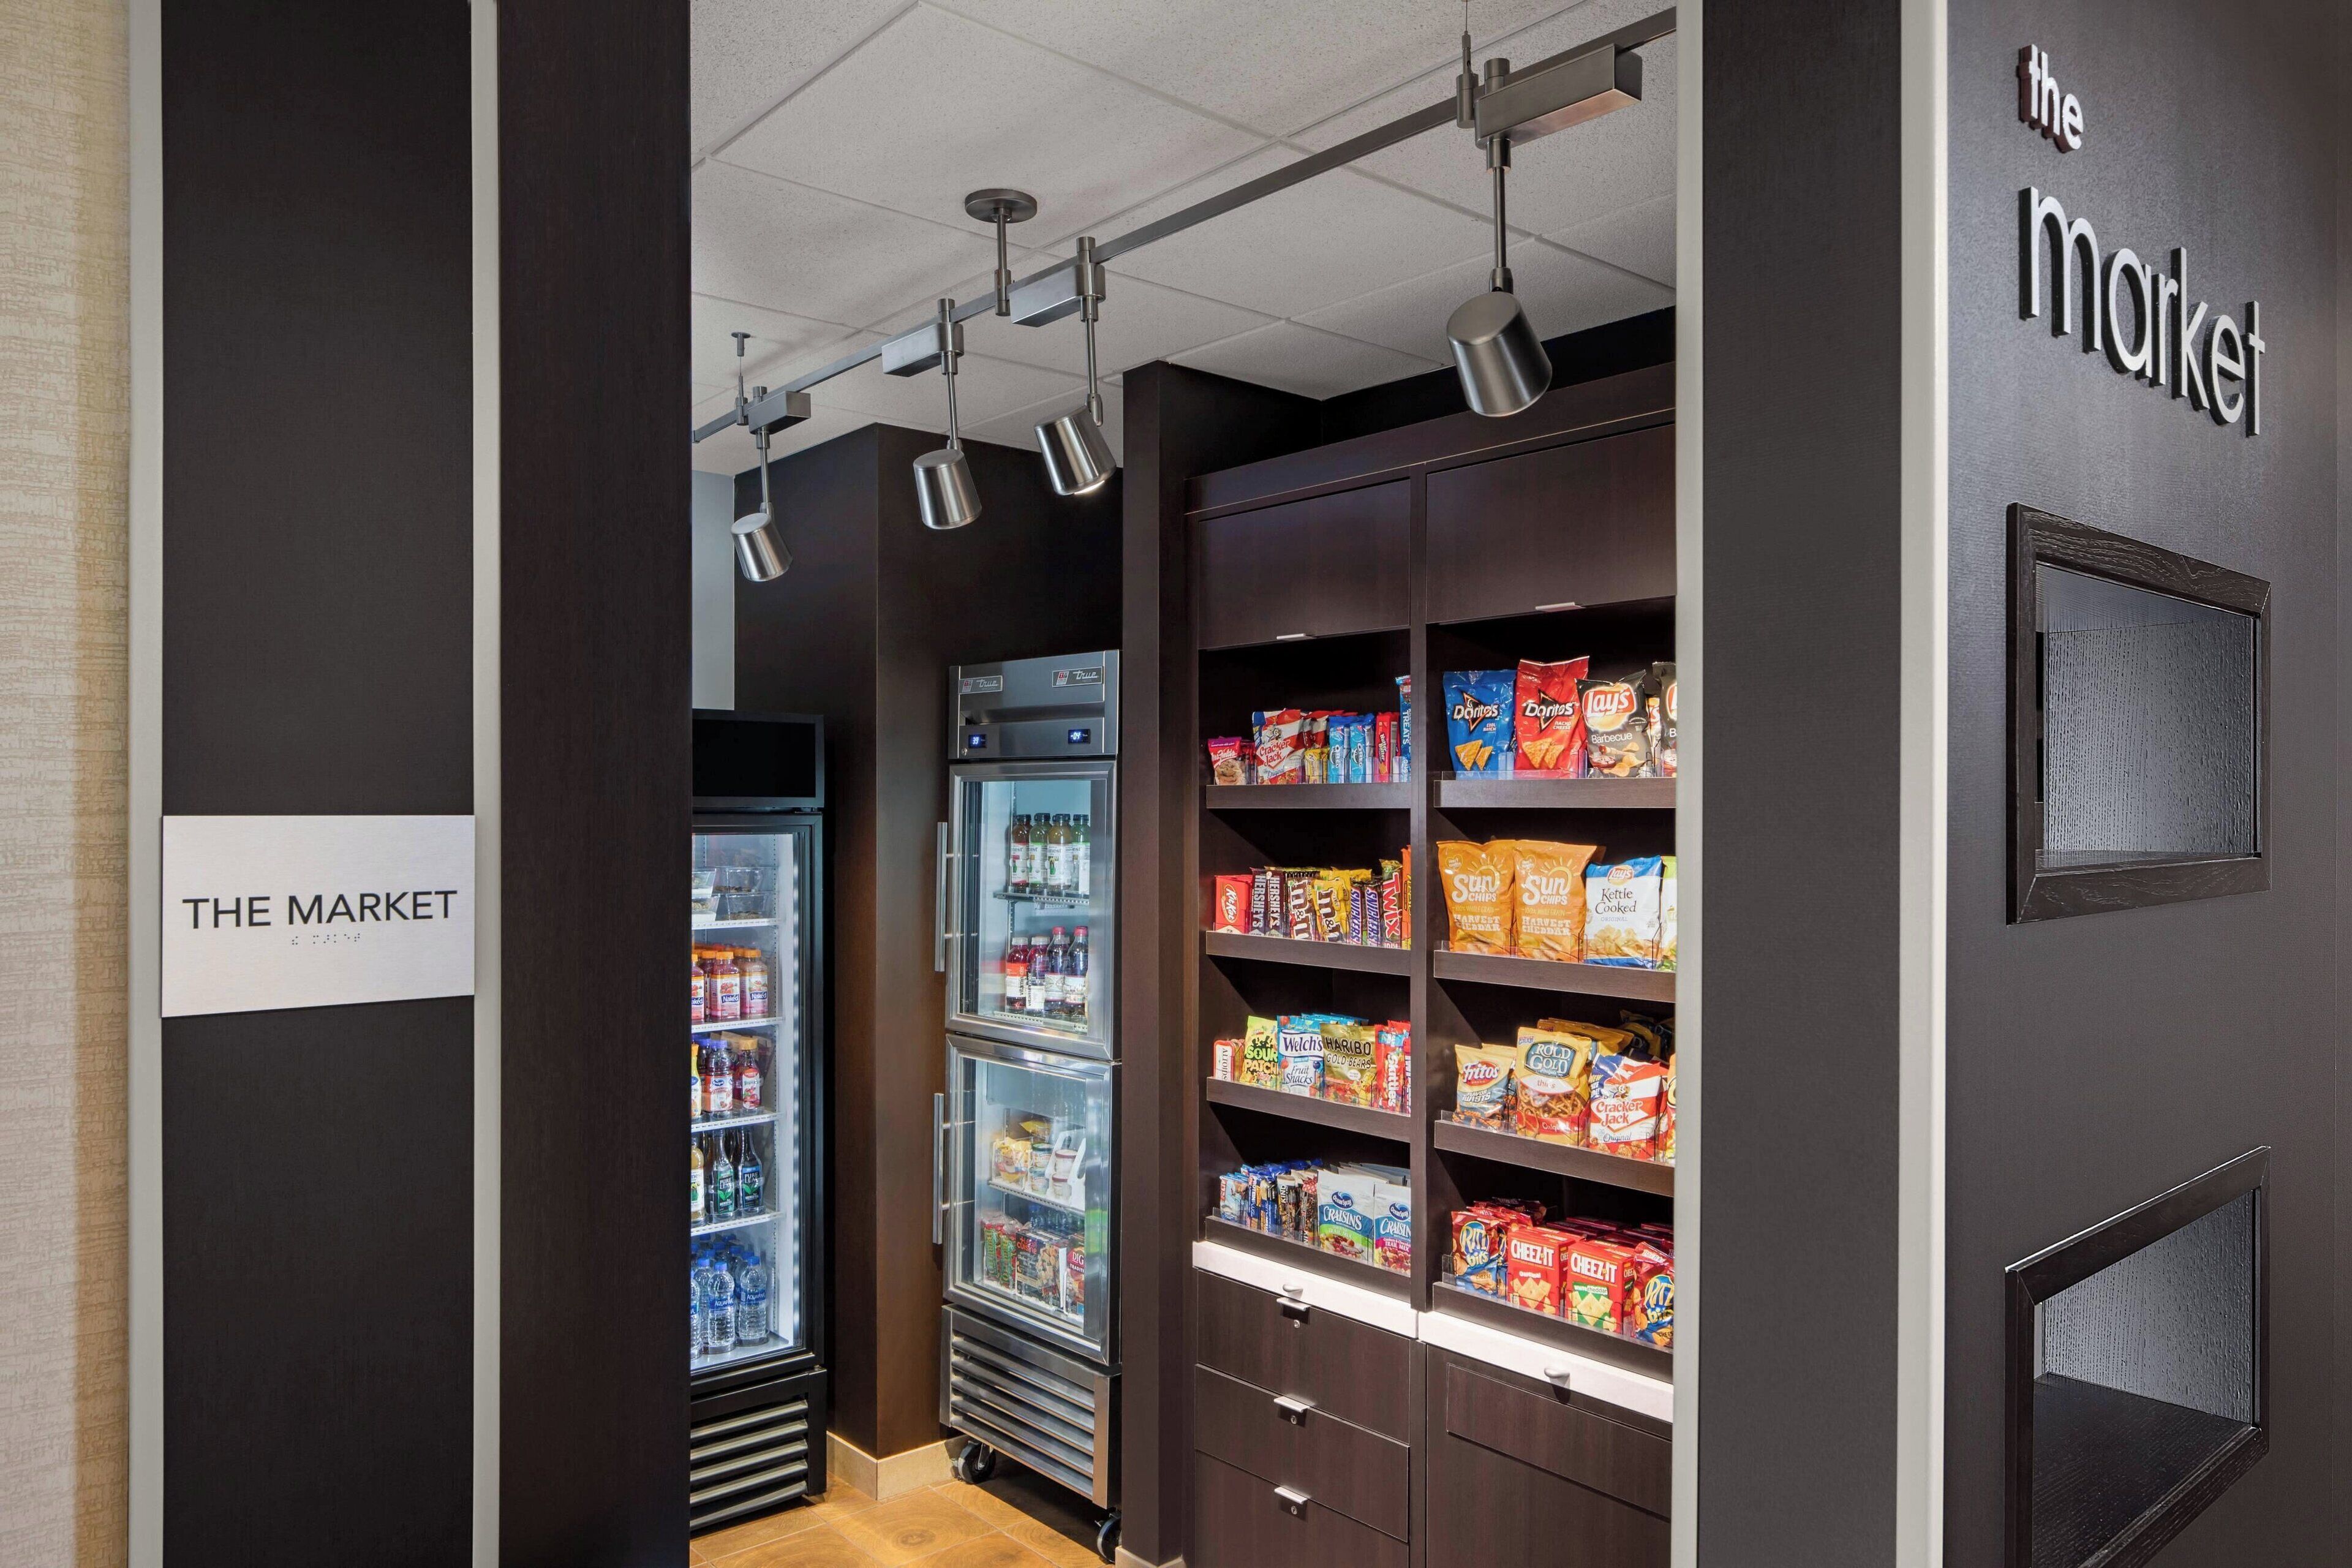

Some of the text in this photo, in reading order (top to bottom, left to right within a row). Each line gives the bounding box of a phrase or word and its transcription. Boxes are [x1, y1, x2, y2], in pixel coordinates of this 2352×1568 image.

[2024, 43, 2084, 151] the
[2025, 186, 2266, 435] market
[1453, 704, 1499, 719] Doritos
[1524, 702, 1574, 717] Doritos
[1591, 732, 1633, 744] Barbecue
[1259, 739, 1291, 756] Cracker
[1264, 751, 1282, 767] Jack
[1452, 873, 1500, 903] Sun
[1522, 875, 1572, 905] Sun
[1600, 888, 1633, 902] Kettle
[1382, 872, 1401, 938] TWIX
[1468, 892, 1496, 902] CHIPS
[1540, 895, 1568, 905] CHIPS
[182, 890, 458, 929] THE MARKET
[1595, 900, 1637, 914] Cooked
[1350, 889, 1361, 942] SNICKERS
[1366, 889, 1380, 943] SNICKERS
[1453, 914, 1501, 924] HARVEST
[1522, 916, 1571, 927] HARVEST
[1283, 1036, 1323, 1052] Welch's
[1325, 1036, 1372, 1056] HARIBO
[1536, 1042, 1571, 1060] ROLD
[1245, 1045, 1278, 1063] SOUR
[1244, 1058, 1278, 1076] PATCH
[1291, 1058, 1310, 1075] Fruit
[1463, 1061, 1499, 1083] Fritos
[1529, 1055, 1569, 1074] GOLD
[1284, 1072, 1313, 1085] Snacks
[1462, 1092, 1491, 1102] TWISTS
[1596, 1101, 1643, 1114] Cracker
[1601, 1113, 1629, 1127] Jack
[1603, 1132, 1632, 1143] Original
[1324, 1205, 1362, 1231] CRAISINS
[1460, 1225, 1487, 1253] RITZ
[1398, 1243, 1409, 1252] MIX
[1467, 1252, 1489, 1267] bits
